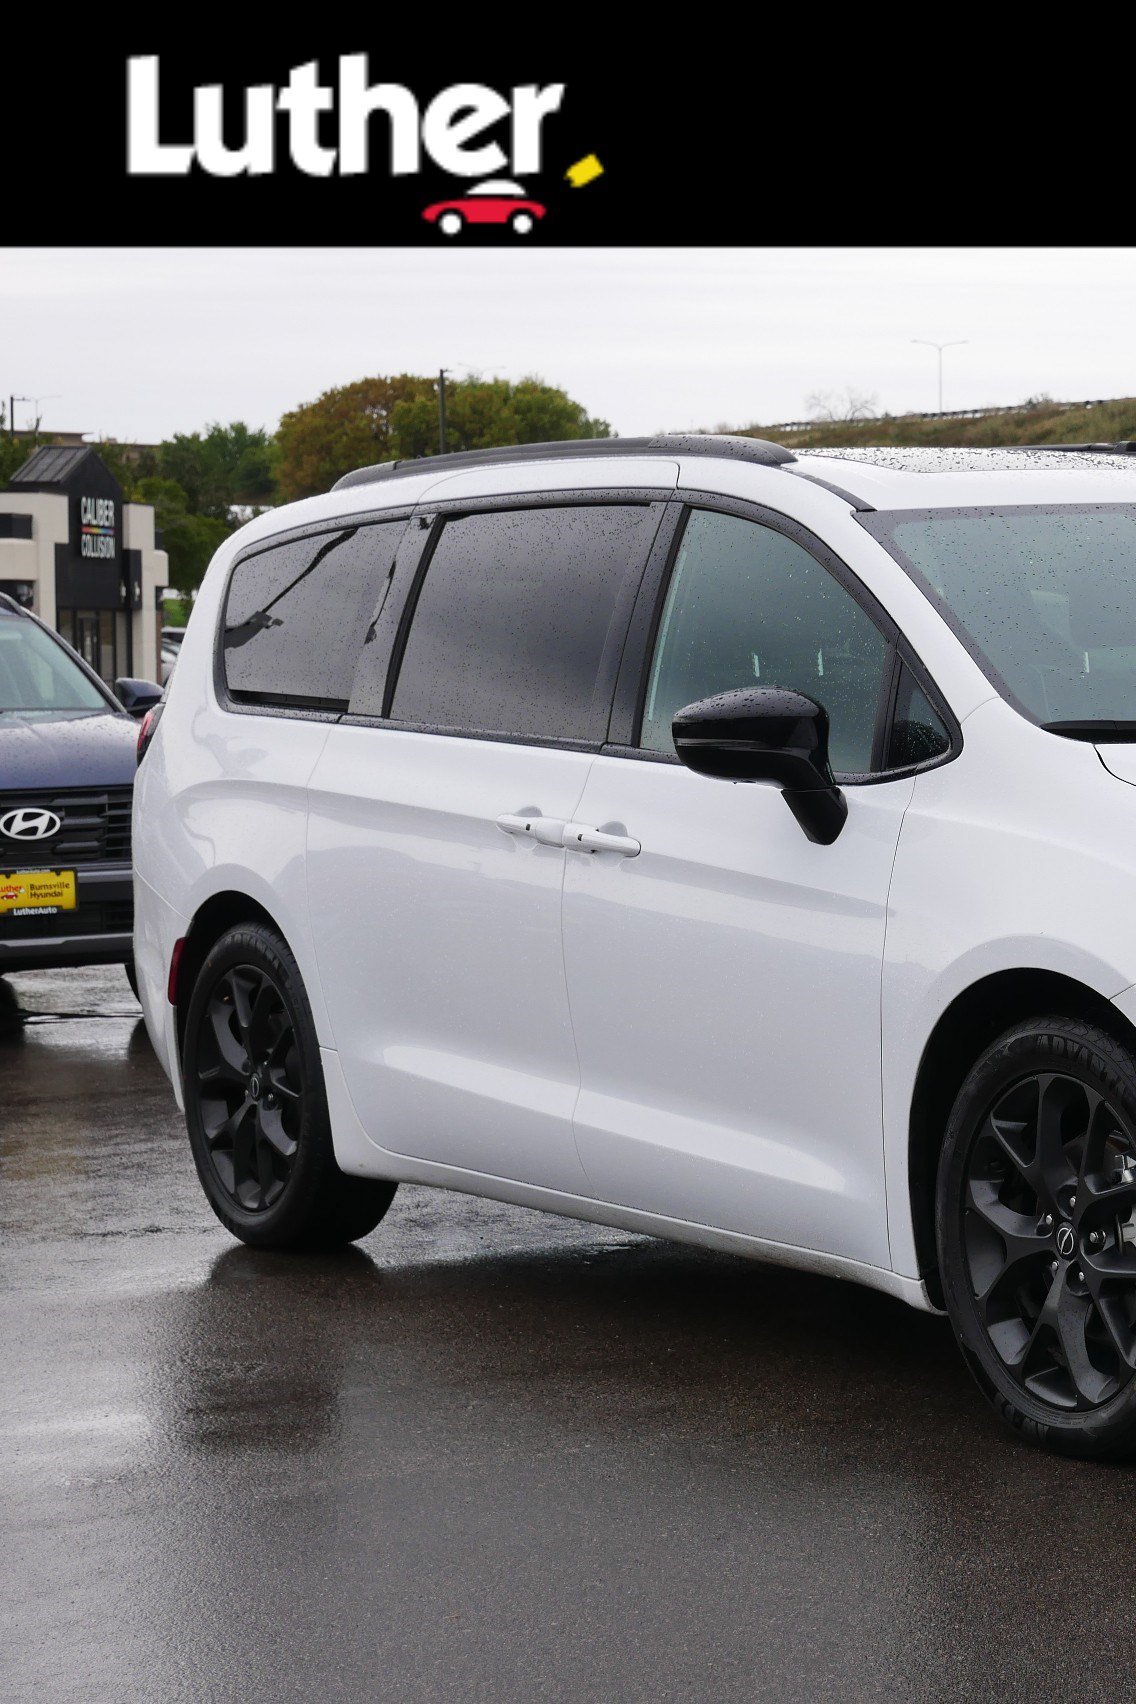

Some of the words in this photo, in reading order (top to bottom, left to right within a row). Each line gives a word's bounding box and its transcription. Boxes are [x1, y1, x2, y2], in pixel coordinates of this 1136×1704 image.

[81, 496, 114, 527] CALIBER
[81, 534, 116, 559] COLLISION
[0, 884, 22, 893] uther
[29, 881, 71, 891] Burnsville
[29, 890, 64, 900] Hyundai
[13, 906, 58, 916] LutherAuto
